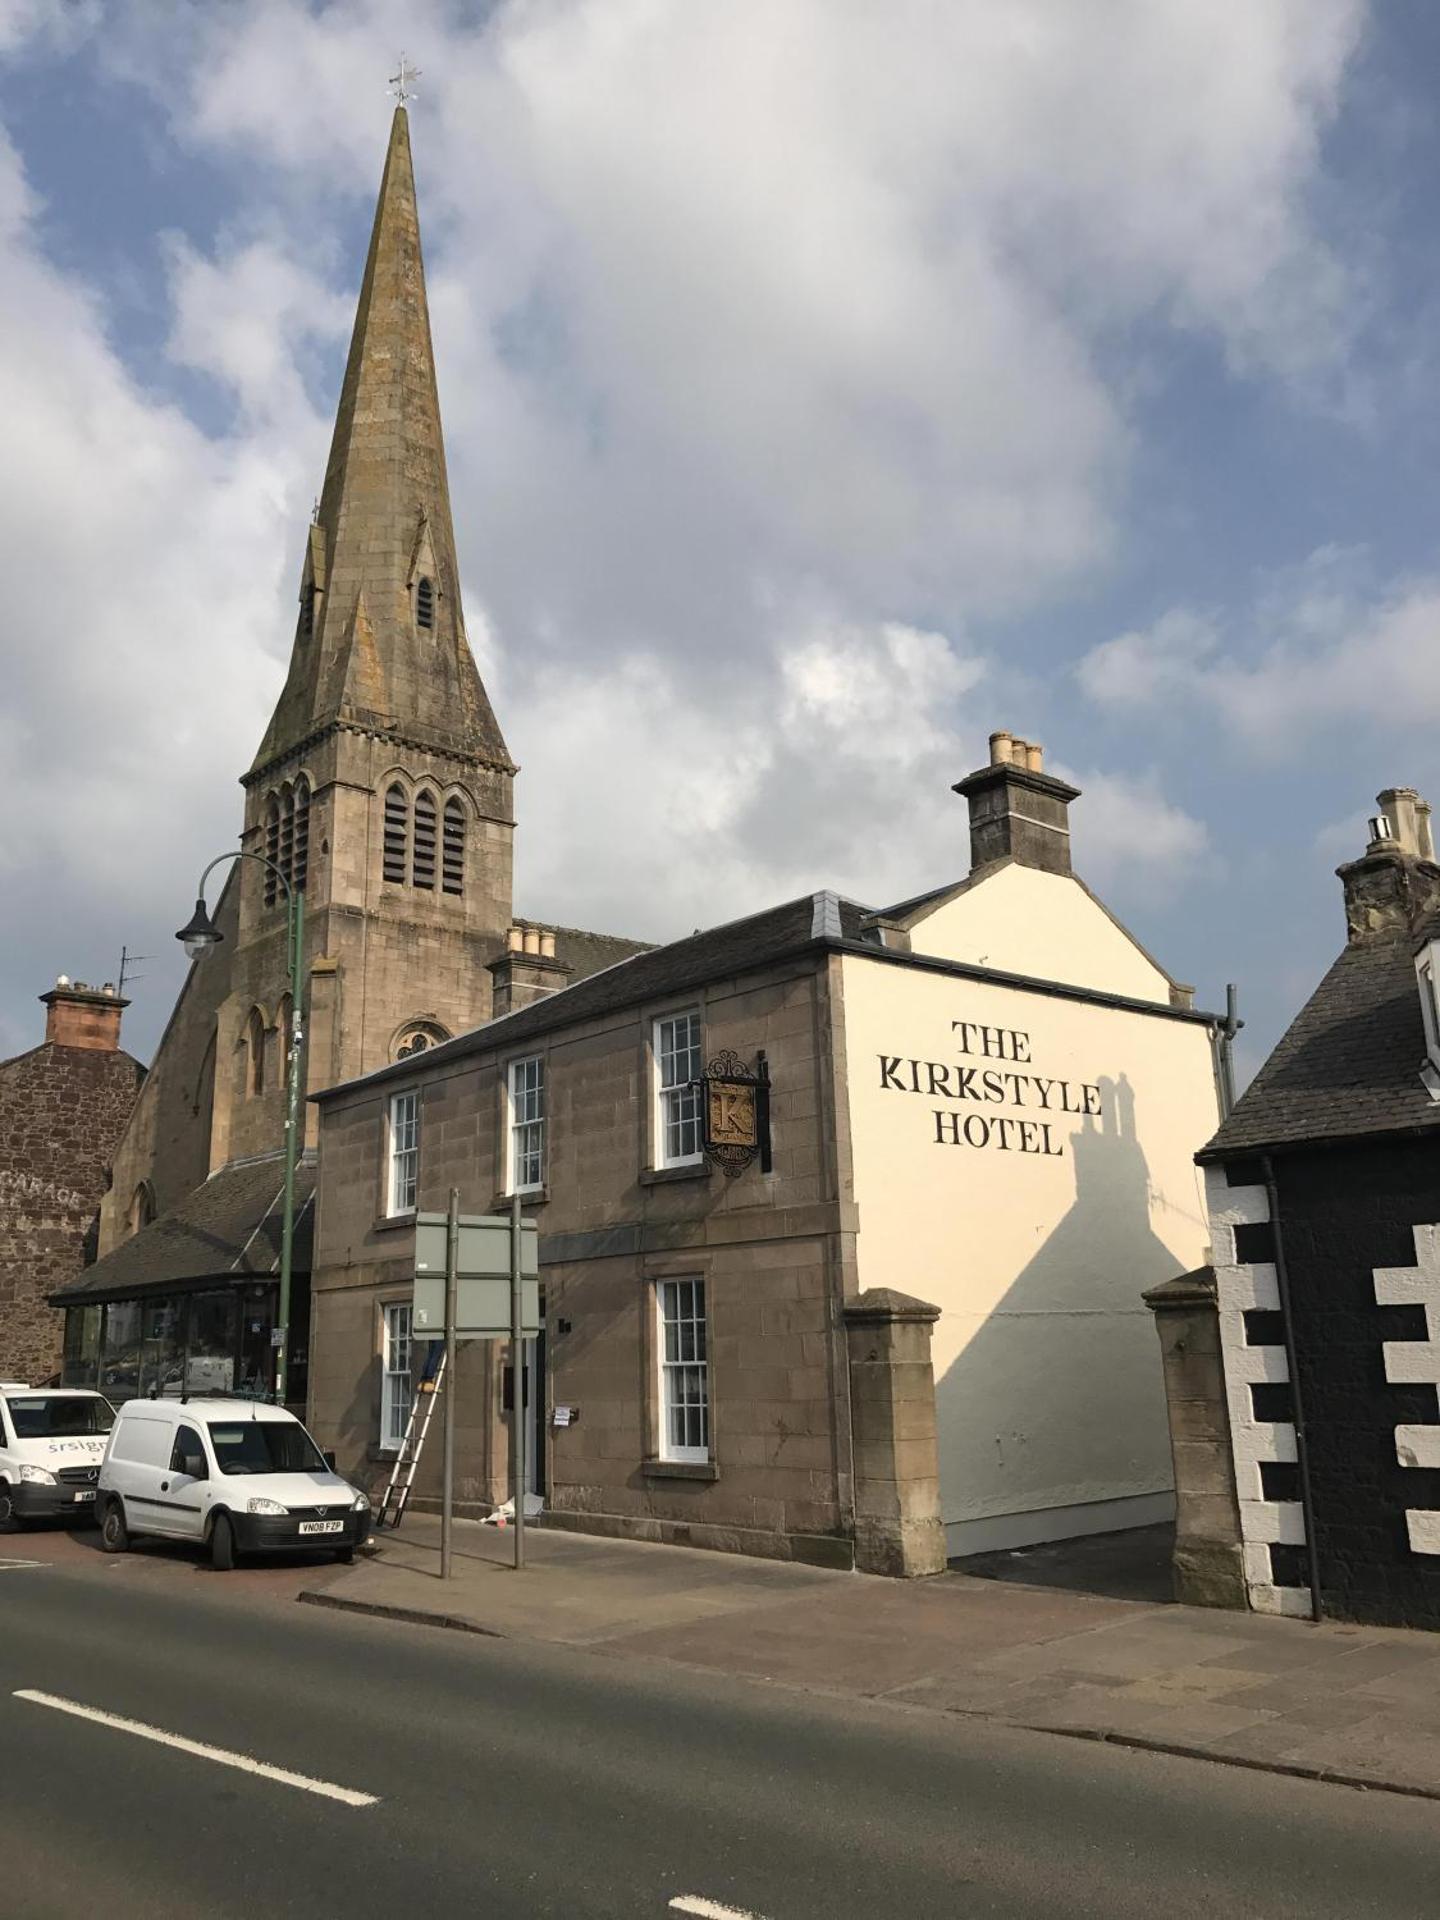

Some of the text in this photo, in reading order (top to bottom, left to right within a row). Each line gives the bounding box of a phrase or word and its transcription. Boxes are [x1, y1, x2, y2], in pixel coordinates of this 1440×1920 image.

[952, 1021, 1031, 1063] THE
[877, 1054, 1102, 1116] KIRKSTYLE
[932, 1110, 1063, 1156] HOTEL
